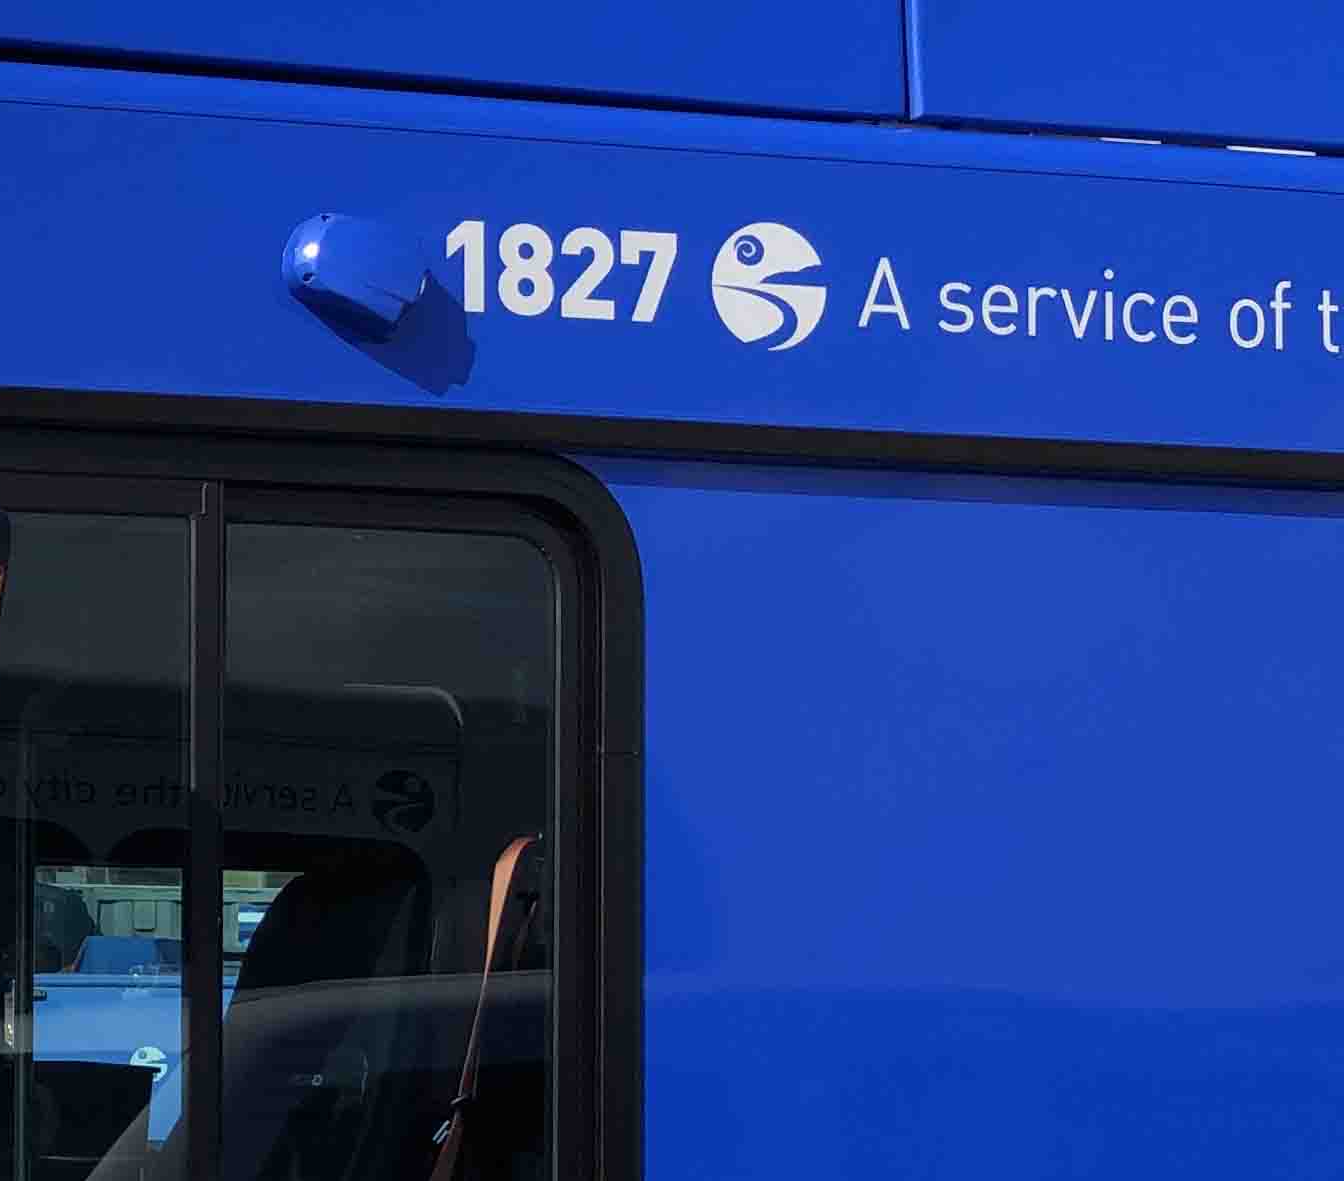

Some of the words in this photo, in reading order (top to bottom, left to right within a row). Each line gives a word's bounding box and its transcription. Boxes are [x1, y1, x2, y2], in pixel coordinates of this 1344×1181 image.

[446, 220, 678, 323] 1827
[858, 257, 911, 330] A
[938, 269, 1199, 345] service
[1229, 280, 1292, 350] of
